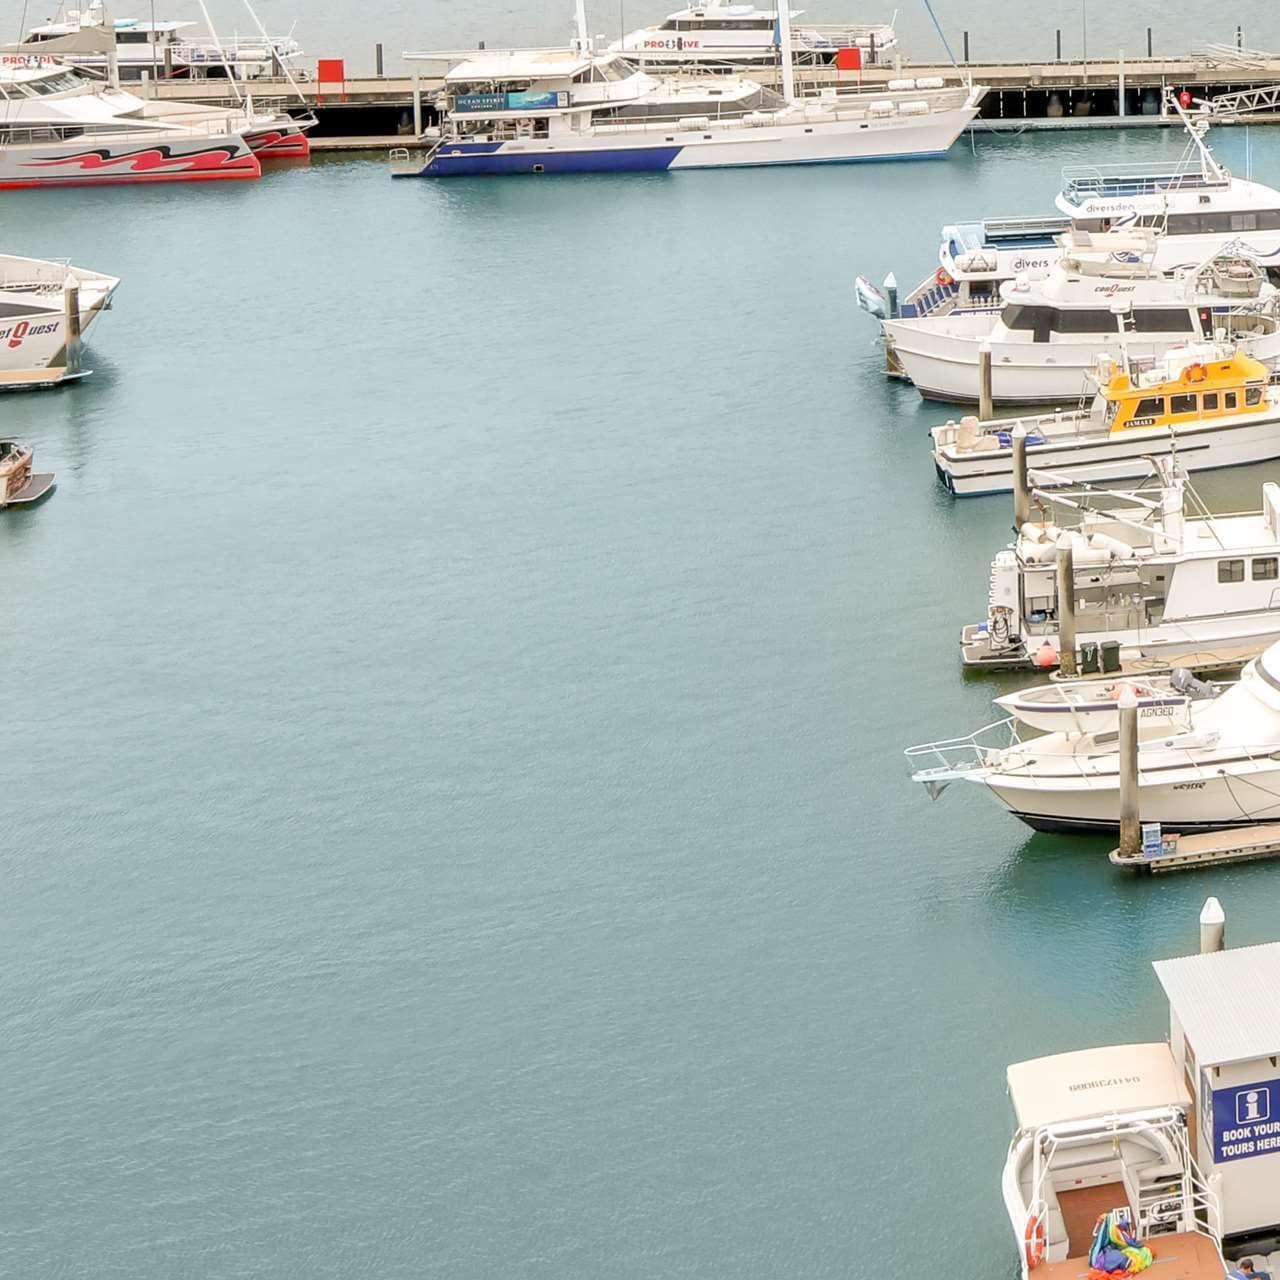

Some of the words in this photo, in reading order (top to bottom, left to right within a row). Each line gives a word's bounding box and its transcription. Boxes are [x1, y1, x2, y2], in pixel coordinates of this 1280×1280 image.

[643, 40, 664, 49] PRO
[2, 56, 25, 65] PRO
[1222, 1127, 1252, 1142] BOOK
[1252, 1121, 1280, 1137] YOUR
[1221, 1141, 1255, 1157] TOURS
